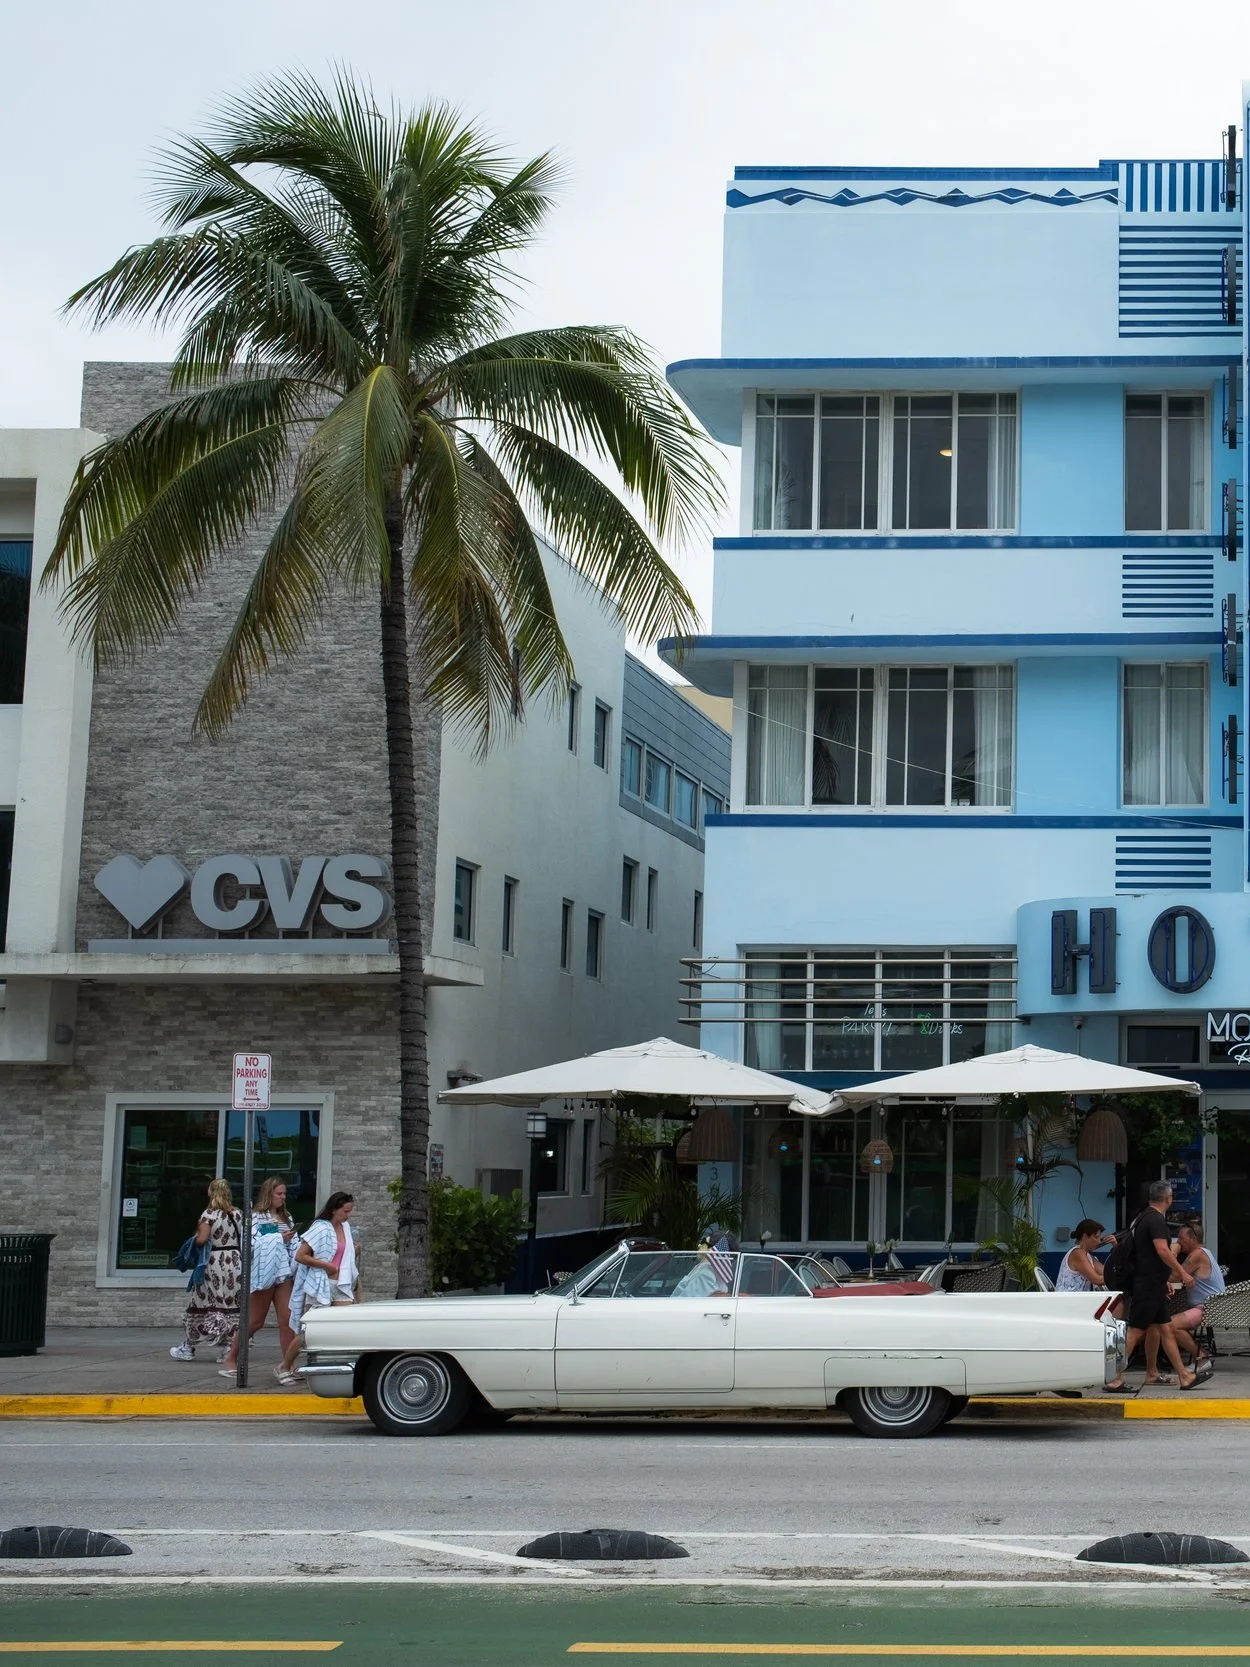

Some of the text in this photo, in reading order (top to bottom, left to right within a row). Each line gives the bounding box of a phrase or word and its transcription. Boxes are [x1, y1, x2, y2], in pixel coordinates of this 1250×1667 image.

[190, 853, 393, 933] CVS
[245, 1056, 259, 1067] NO
[236, 1068, 267, 1079] PARKING
[245, 1080, 258, 1088] ANY
[245, 1088, 258, 1096] TIME
